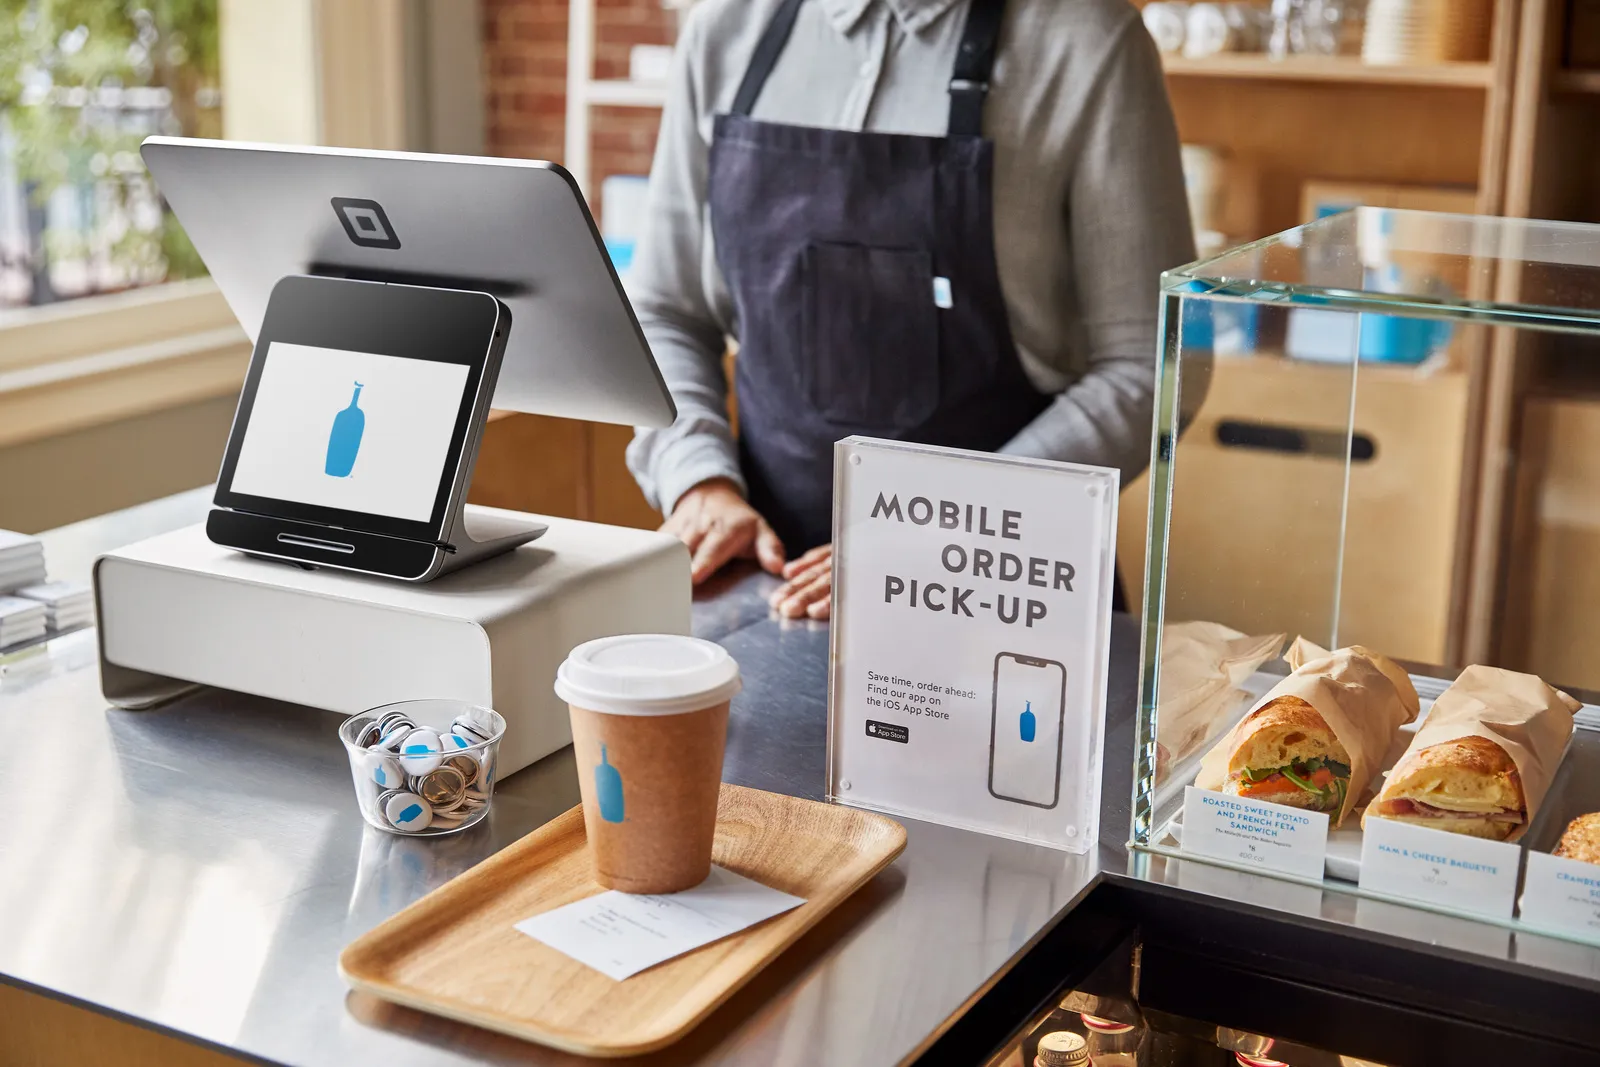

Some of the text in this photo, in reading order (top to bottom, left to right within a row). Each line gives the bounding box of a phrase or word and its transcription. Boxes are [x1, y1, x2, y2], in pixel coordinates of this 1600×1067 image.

[871, 492, 1022, 540] MOBILE
[941, 544, 1075, 592] ORDER
[884, 575, 1047, 628] PICK-UP
[867, 684, 941, 705] Find our app on
[868, 671, 976, 699] Save time, order ahead:
[867, 697, 949, 720] the iOS App Store
[878, 729, 906, 740] App Store
[1203, 797, 1309, 825] ROASTED SWEET POTATO
[1217, 810, 1296, 832] AND FRENCH FETA
[1230, 821, 1277, 837] SANDWICH
[1378, 844, 1400, 854] HAM
[1412, 851, 1447, 865] CHEESE
[1450, 859, 1498, 875] BAGUETTE
